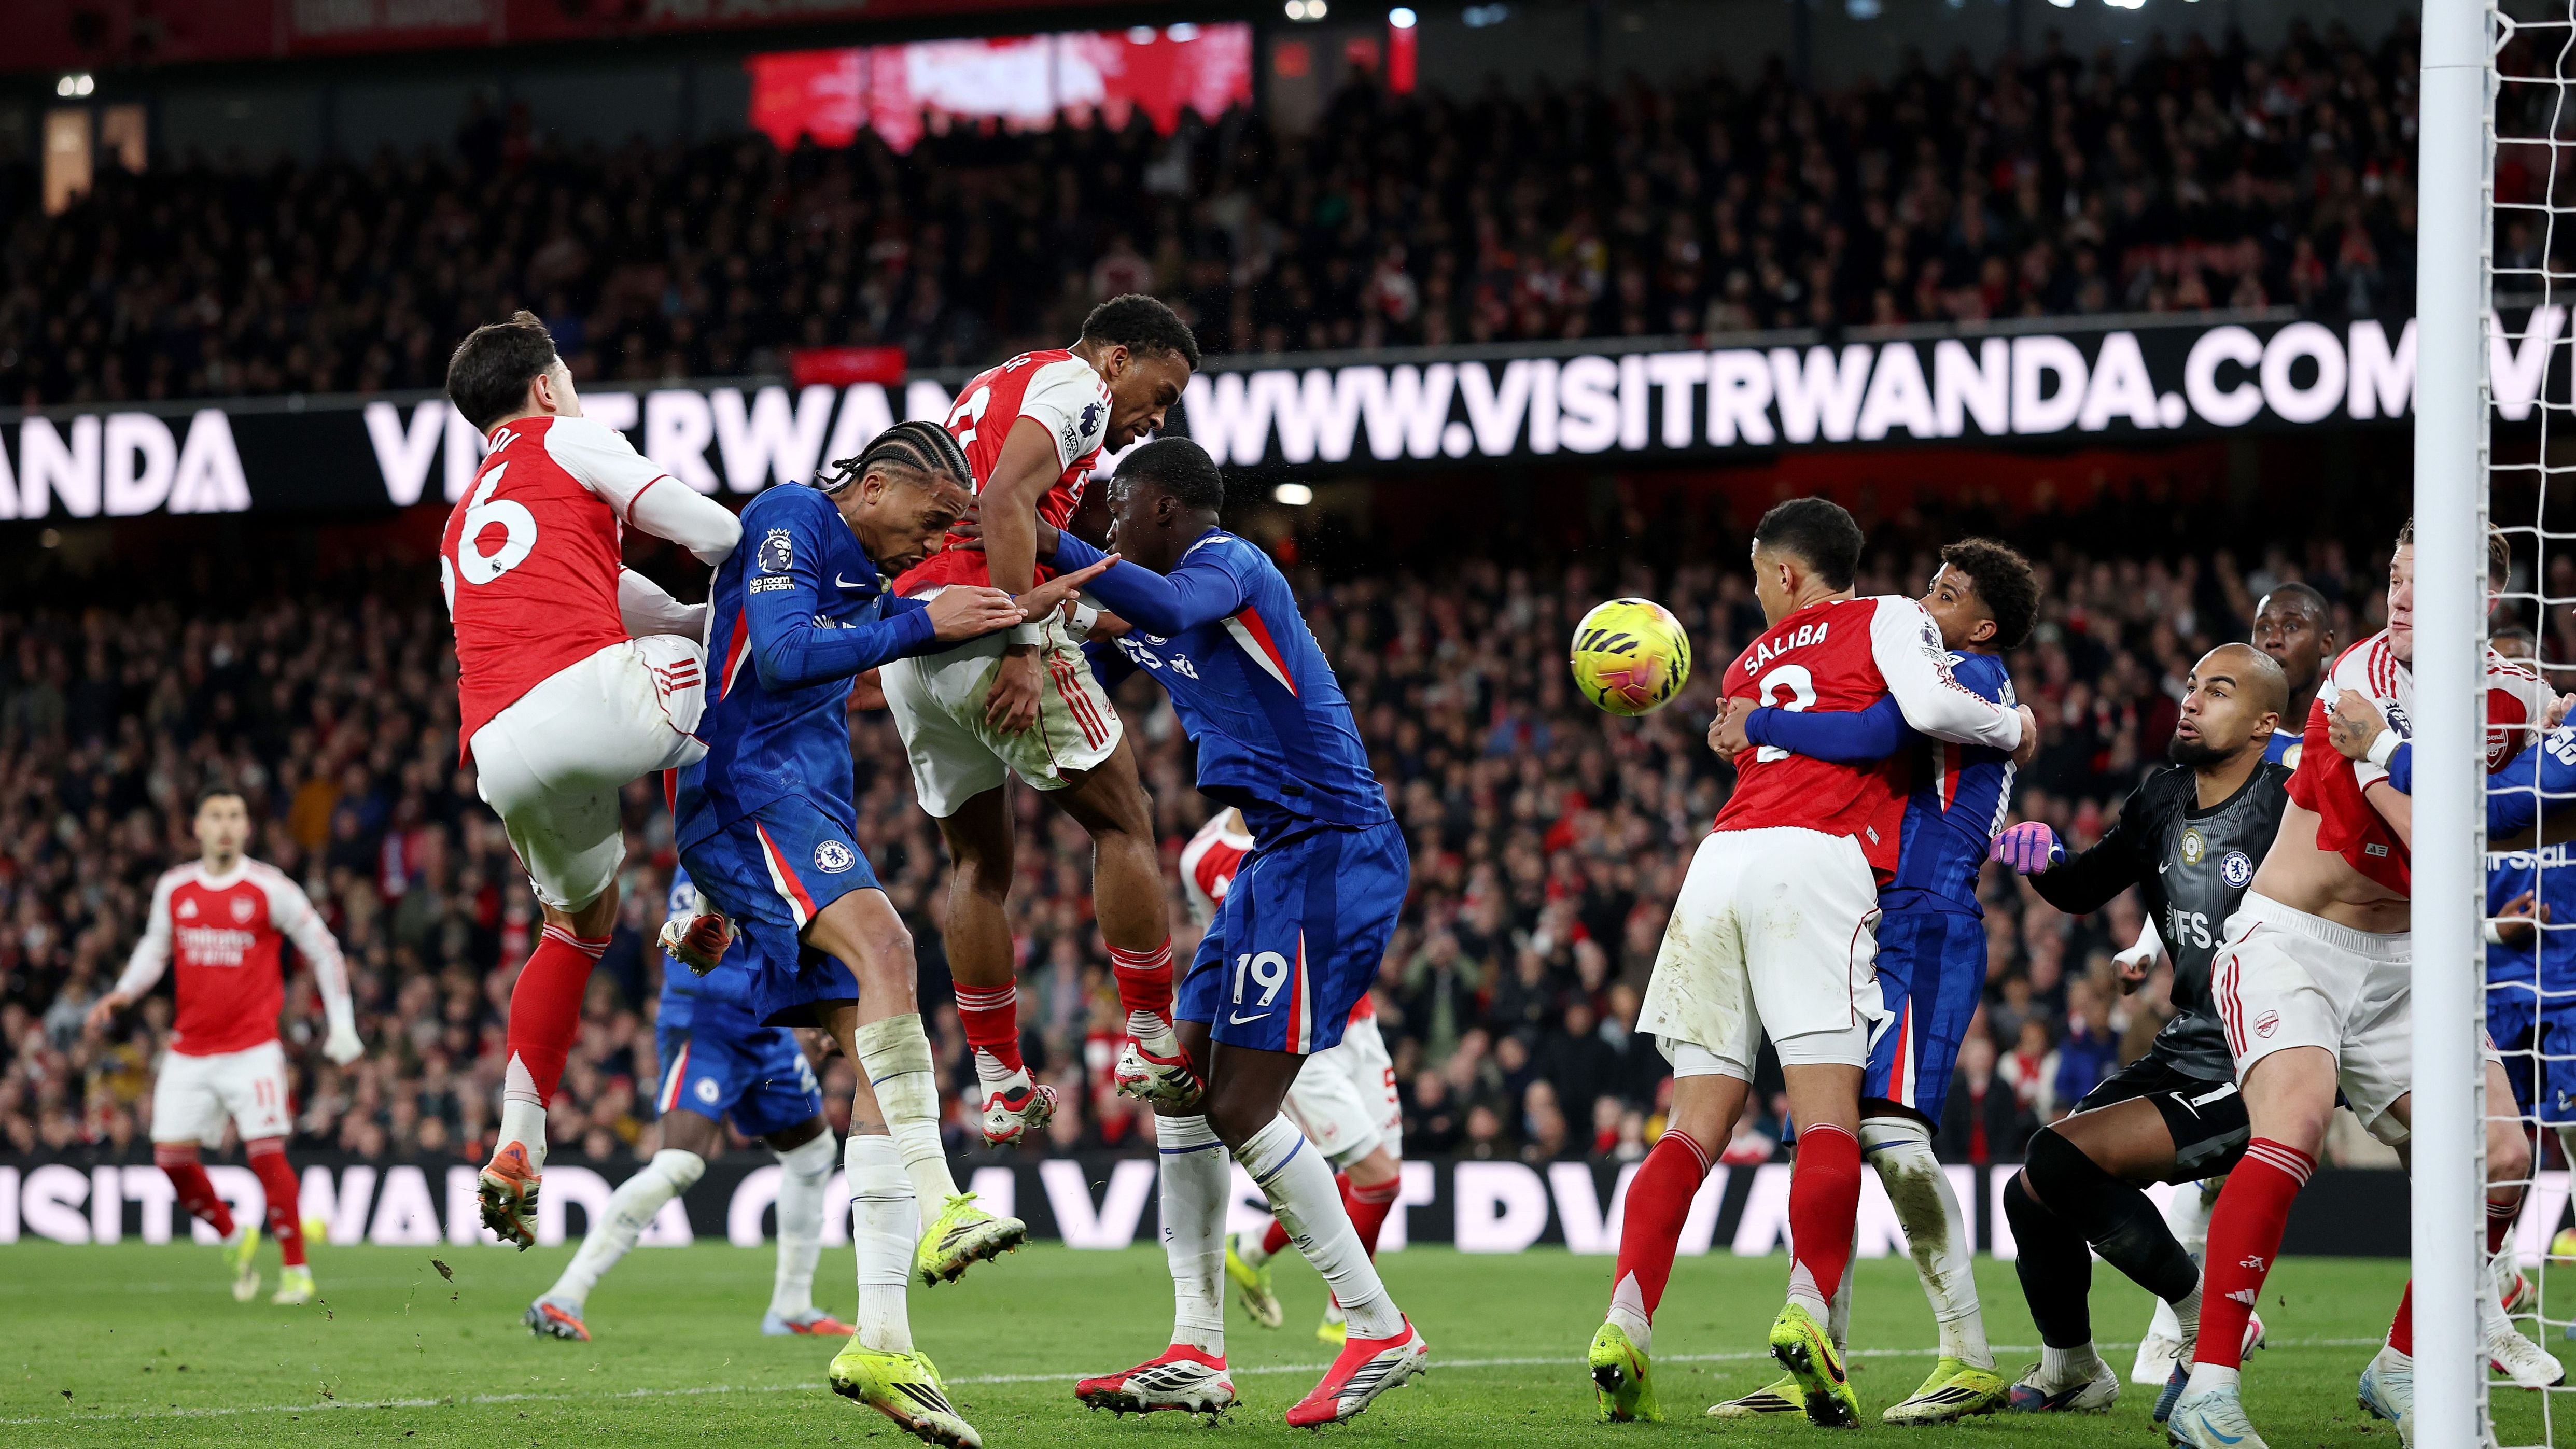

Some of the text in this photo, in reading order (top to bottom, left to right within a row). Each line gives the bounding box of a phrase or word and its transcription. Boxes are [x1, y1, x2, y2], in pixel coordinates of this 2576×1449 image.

[749, 576, 790, 587] No room
[763, 583, 796, 592] racism
[1744, 622, 1829, 677] SALIBA
[817, 841, 841, 854] CHELSEA
[2225, 852, 2246, 861] CHELSEA
[1232, 951, 1289, 1007] 19
[793, 1053, 824, 1098] 2
[254, 1078, 276, 1108] 11
[2190, 1081, 2238, 1107] 1
